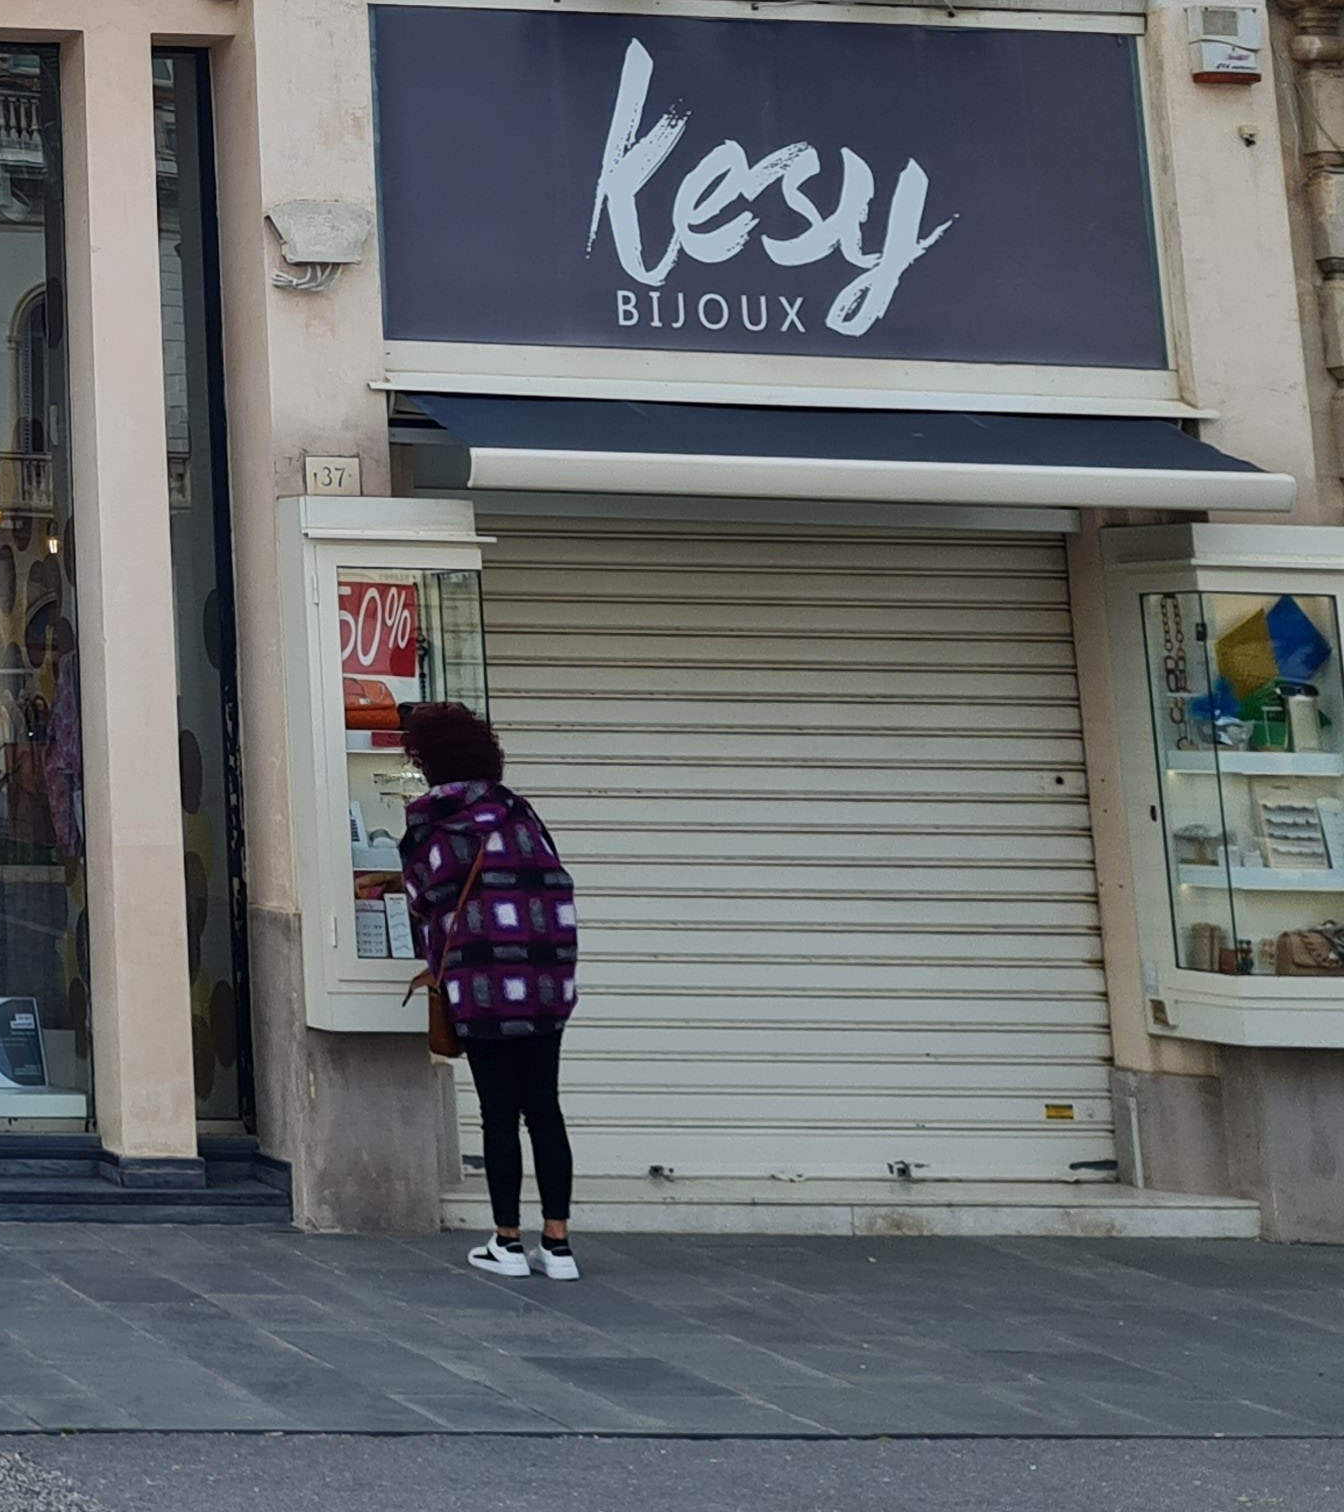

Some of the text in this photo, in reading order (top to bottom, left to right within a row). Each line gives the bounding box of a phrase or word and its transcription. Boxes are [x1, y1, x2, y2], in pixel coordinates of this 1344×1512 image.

[616, 290, 807, 333] BIJOUX
[320, 466, 346, 488] 37
[339, 586, 412, 667] 50%
